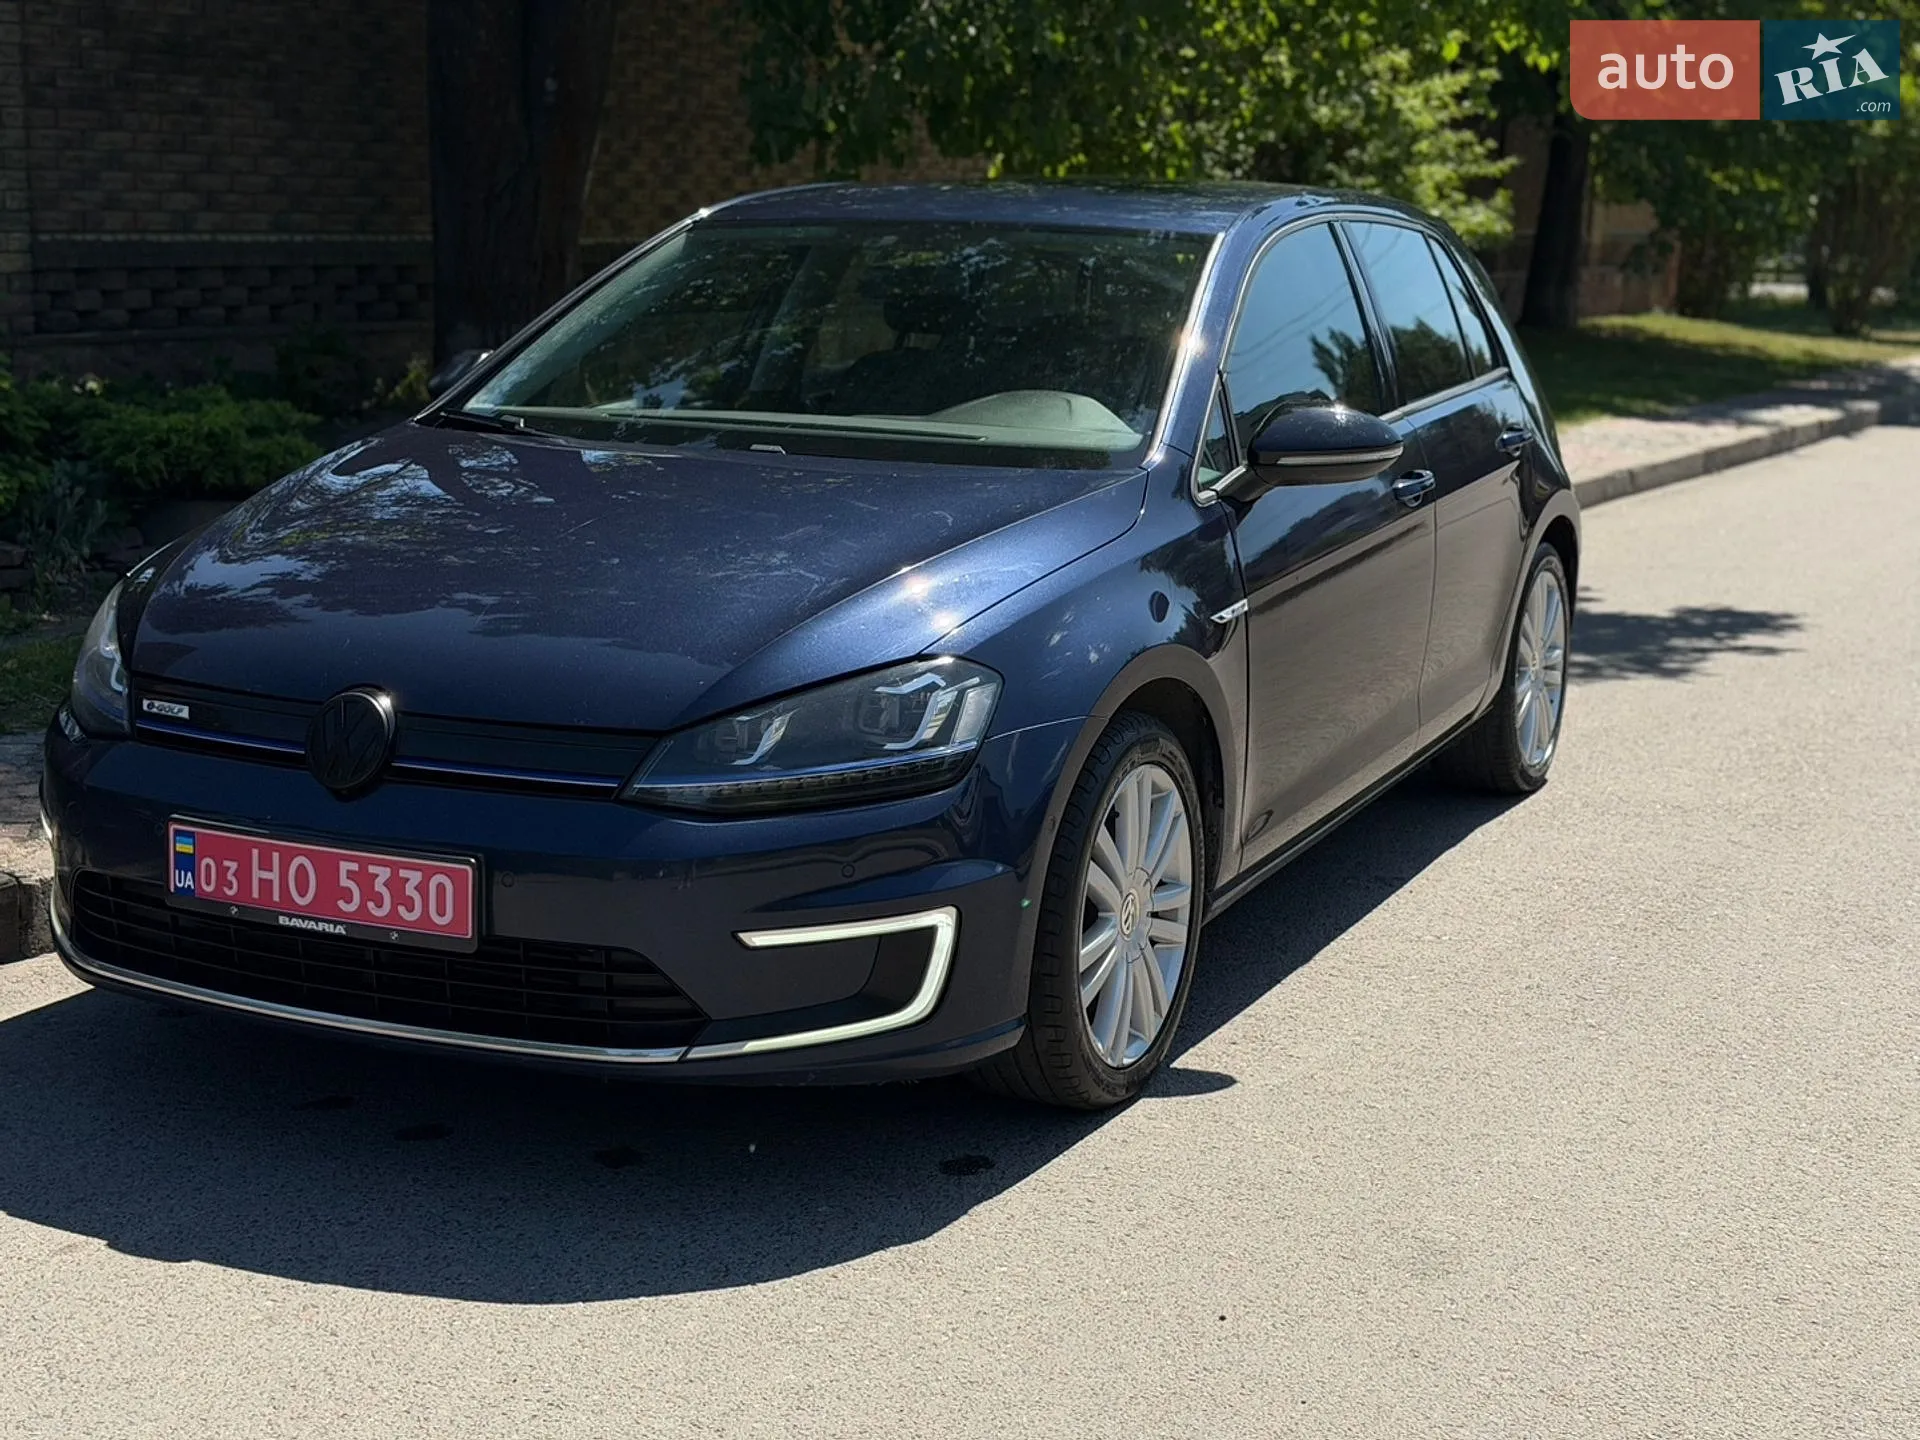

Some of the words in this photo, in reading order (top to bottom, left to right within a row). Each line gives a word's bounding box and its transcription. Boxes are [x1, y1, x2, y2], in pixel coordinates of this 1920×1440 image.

[175, 869, 195, 889] UA
[200, 857, 239, 896] 03
[251, 848, 317, 906] HO
[337, 860, 454, 926] 5330
[278, 915, 347, 935] BAVARIA
